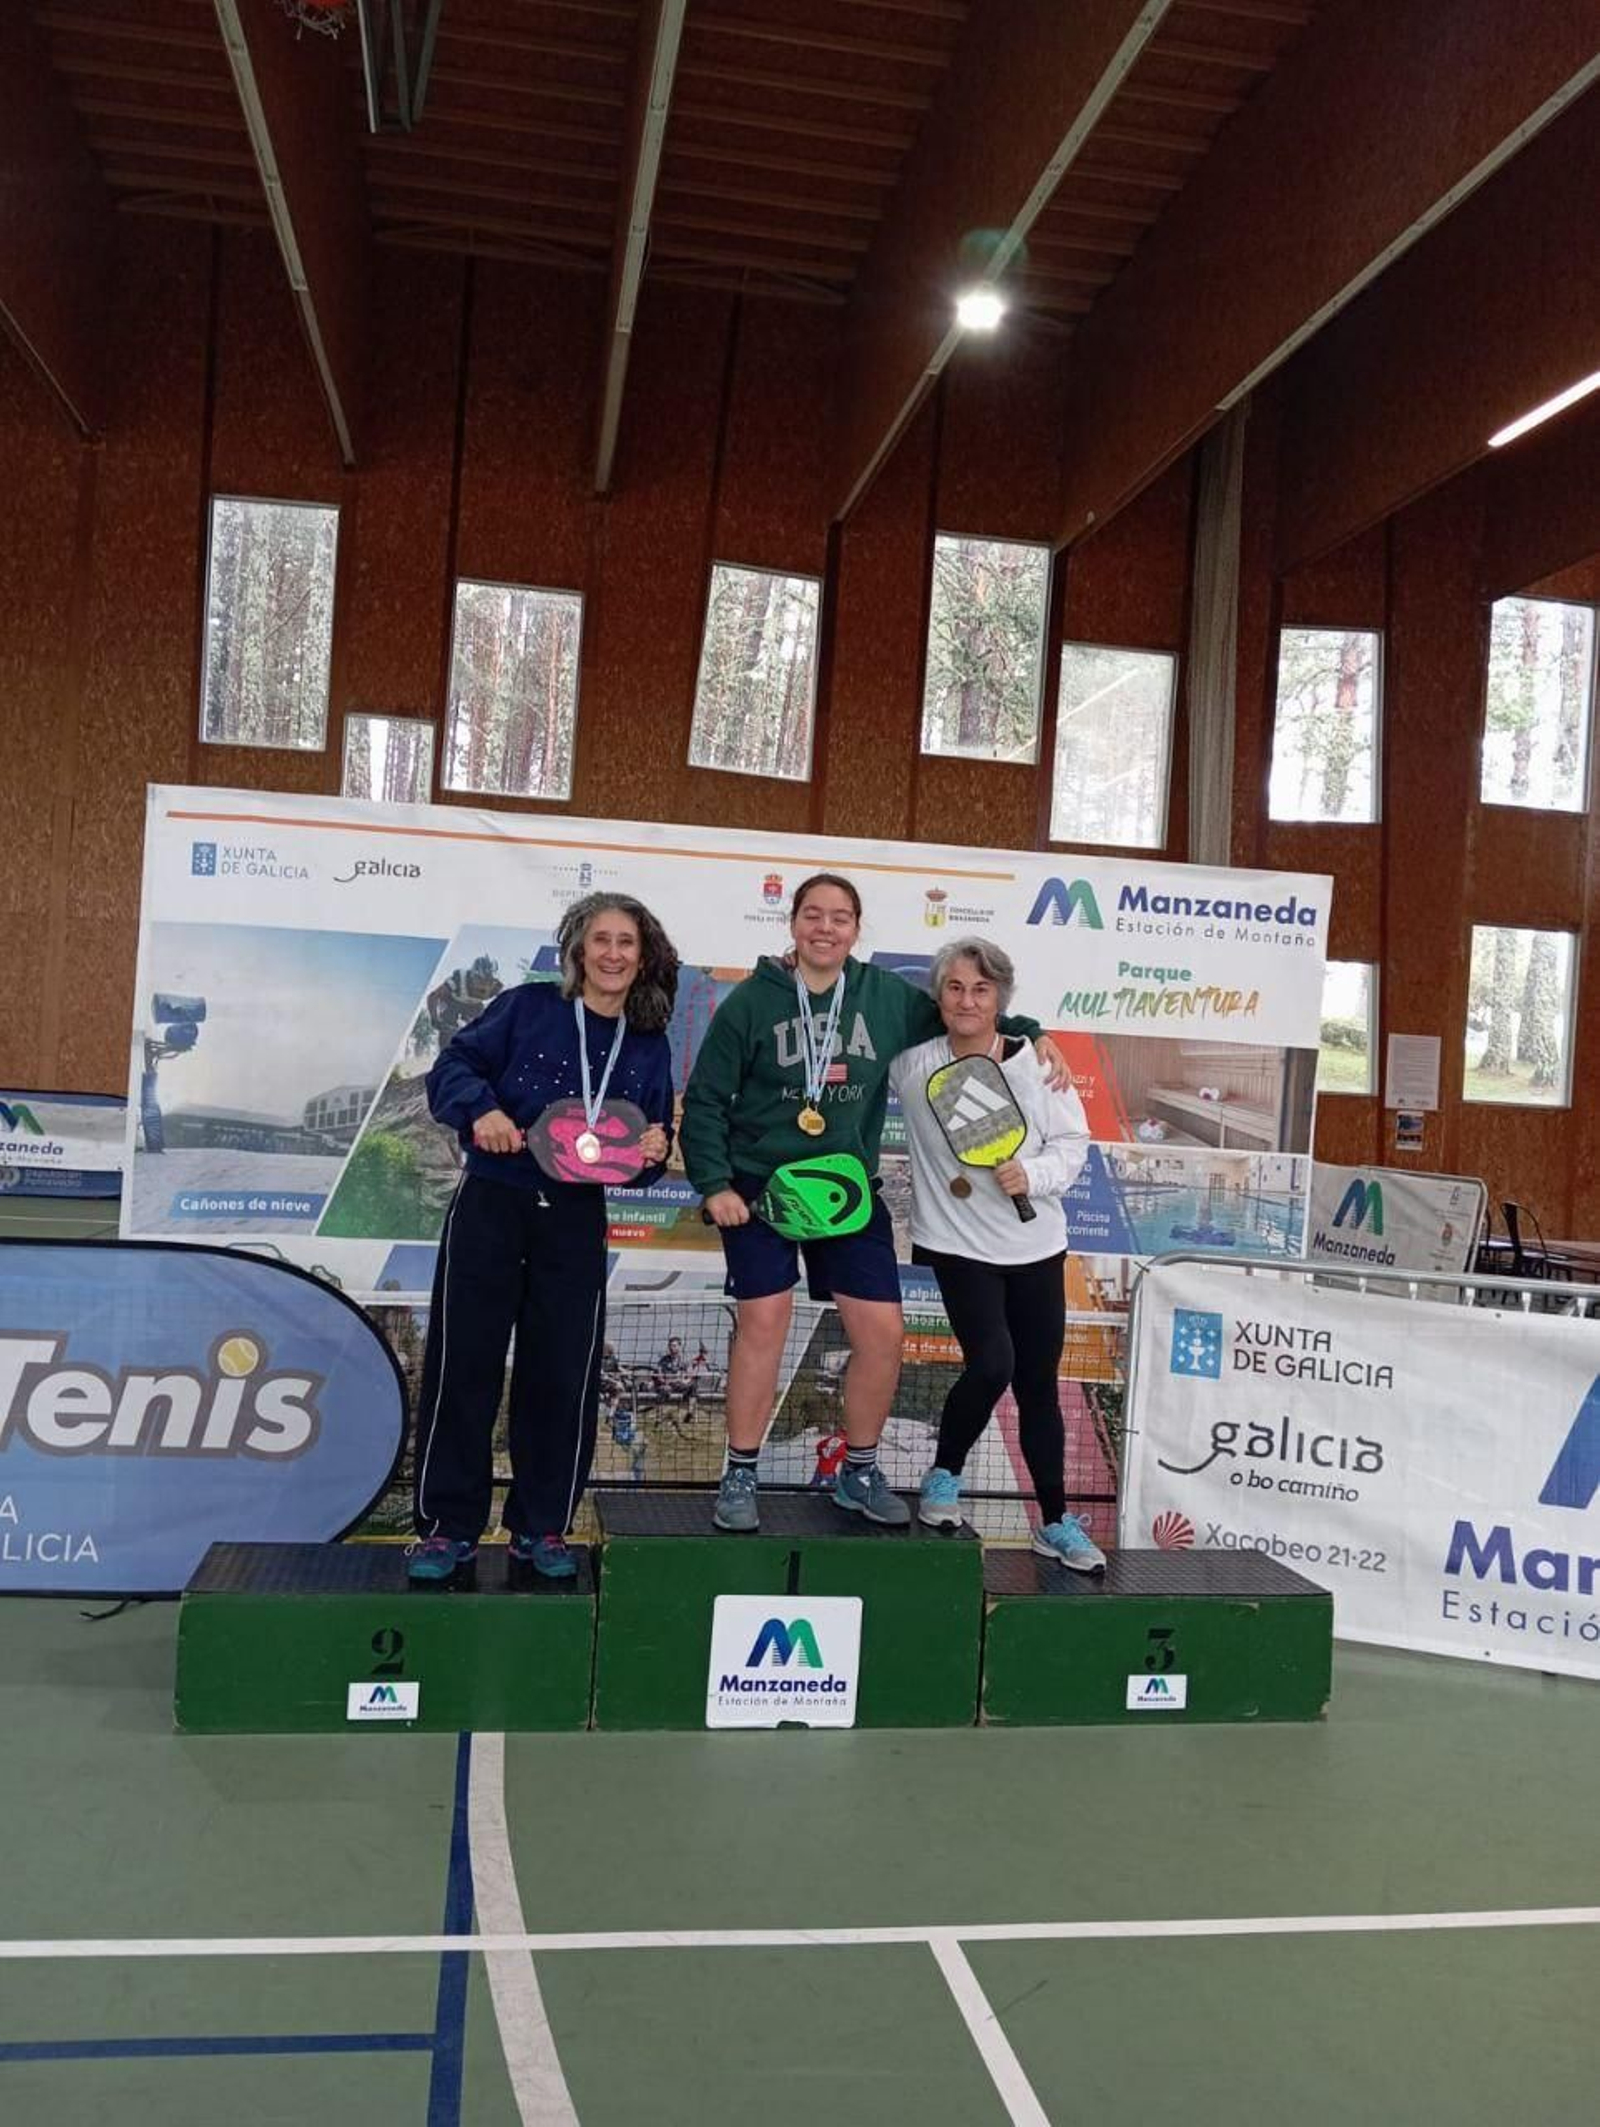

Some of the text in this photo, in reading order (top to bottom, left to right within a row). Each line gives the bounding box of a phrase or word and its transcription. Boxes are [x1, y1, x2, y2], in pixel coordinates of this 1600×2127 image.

[222, 846, 277, 863] XUNTA
[221, 861, 309, 880] DE GALICIA
[333, 858, 421, 882] galicia
[1118, 885, 1317, 927] Manzaneda
[1116, 917, 1316, 947] Estación de Montaña
[1118, 961, 1193, 983] Parque
[1057, 985, 1261, 1021] MULTIAVENTURA
[773, 1011, 877, 1068] USA
[826, 1083, 865, 1102] YORK
[180, 1197, 311, 1213] Cañones de nieve
[647, 1187, 695, 1199] indoor
[622, 1208, 666, 1223] infantil
[611, 1228, 646, 1238] nuevo
[1313, 1232, 1396, 1267] Manzaneda
[1233, 1320, 1332, 1354] XUNTA
[1233, 1349, 1395, 1389] DE GALICIA
[0, 1336, 313, 1453] Tenis
[1157, 1415, 1385, 1475] galicia
[1229, 1470, 1359, 1502] o bo camiño
[3, 1532, 99, 1562] LICIA
[1205, 1522, 1322, 1564] Xacobeo
[371, 1627, 404, 1675] 2
[1145, 1628, 1175, 1671] 3
[719, 1673, 847, 1693] Manzaneda
[718, 1696, 768, 1706] Estación
[773, 1696, 788, 1706] de
